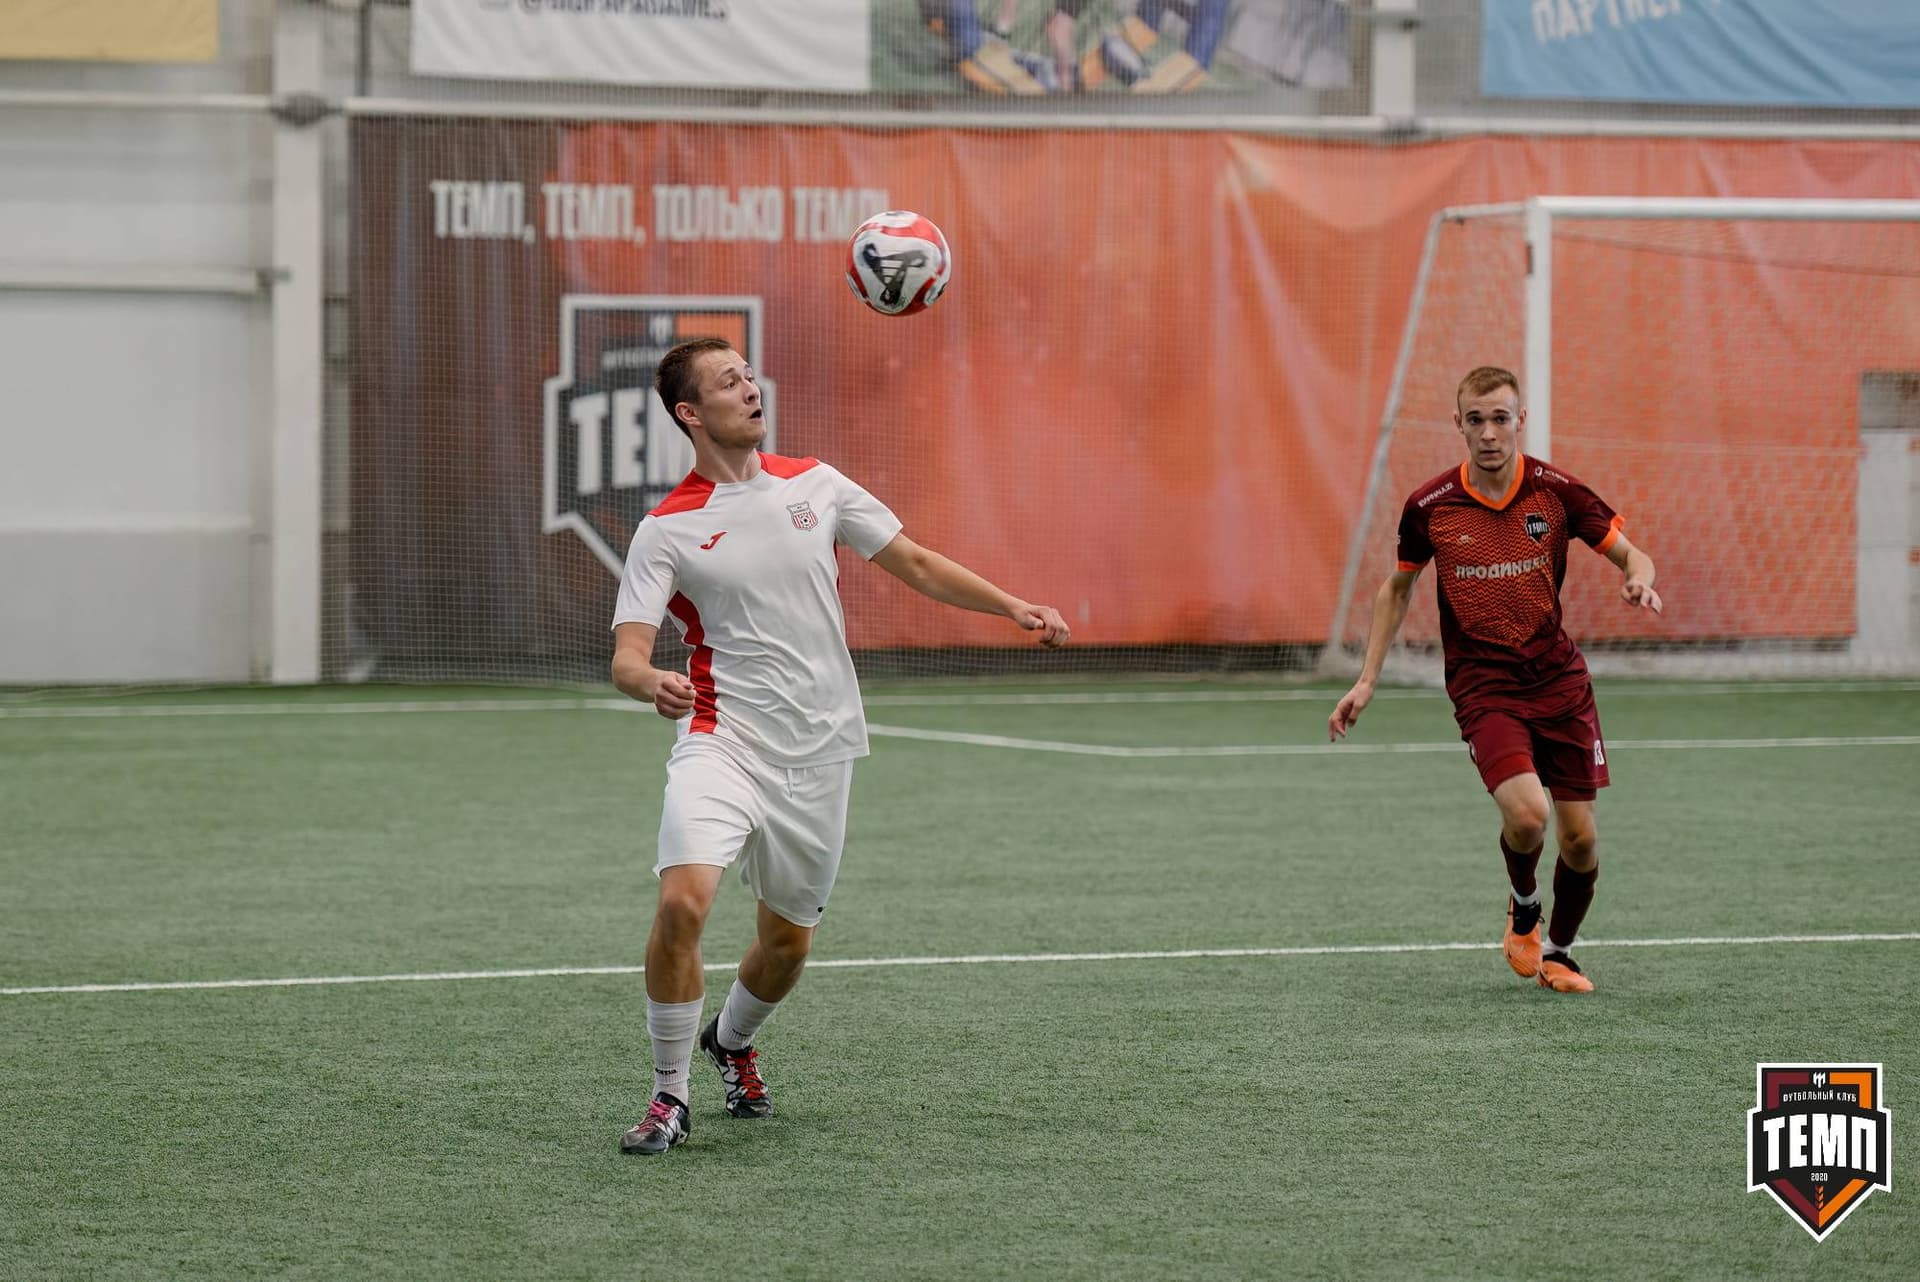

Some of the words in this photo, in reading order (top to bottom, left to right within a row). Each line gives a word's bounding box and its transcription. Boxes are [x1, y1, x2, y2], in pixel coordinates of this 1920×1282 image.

[430, 179, 535, 244] ТЕМП,
[541, 182, 646, 246] ТЕМП,
[652, 183, 784, 242] ТОЛЬКО
